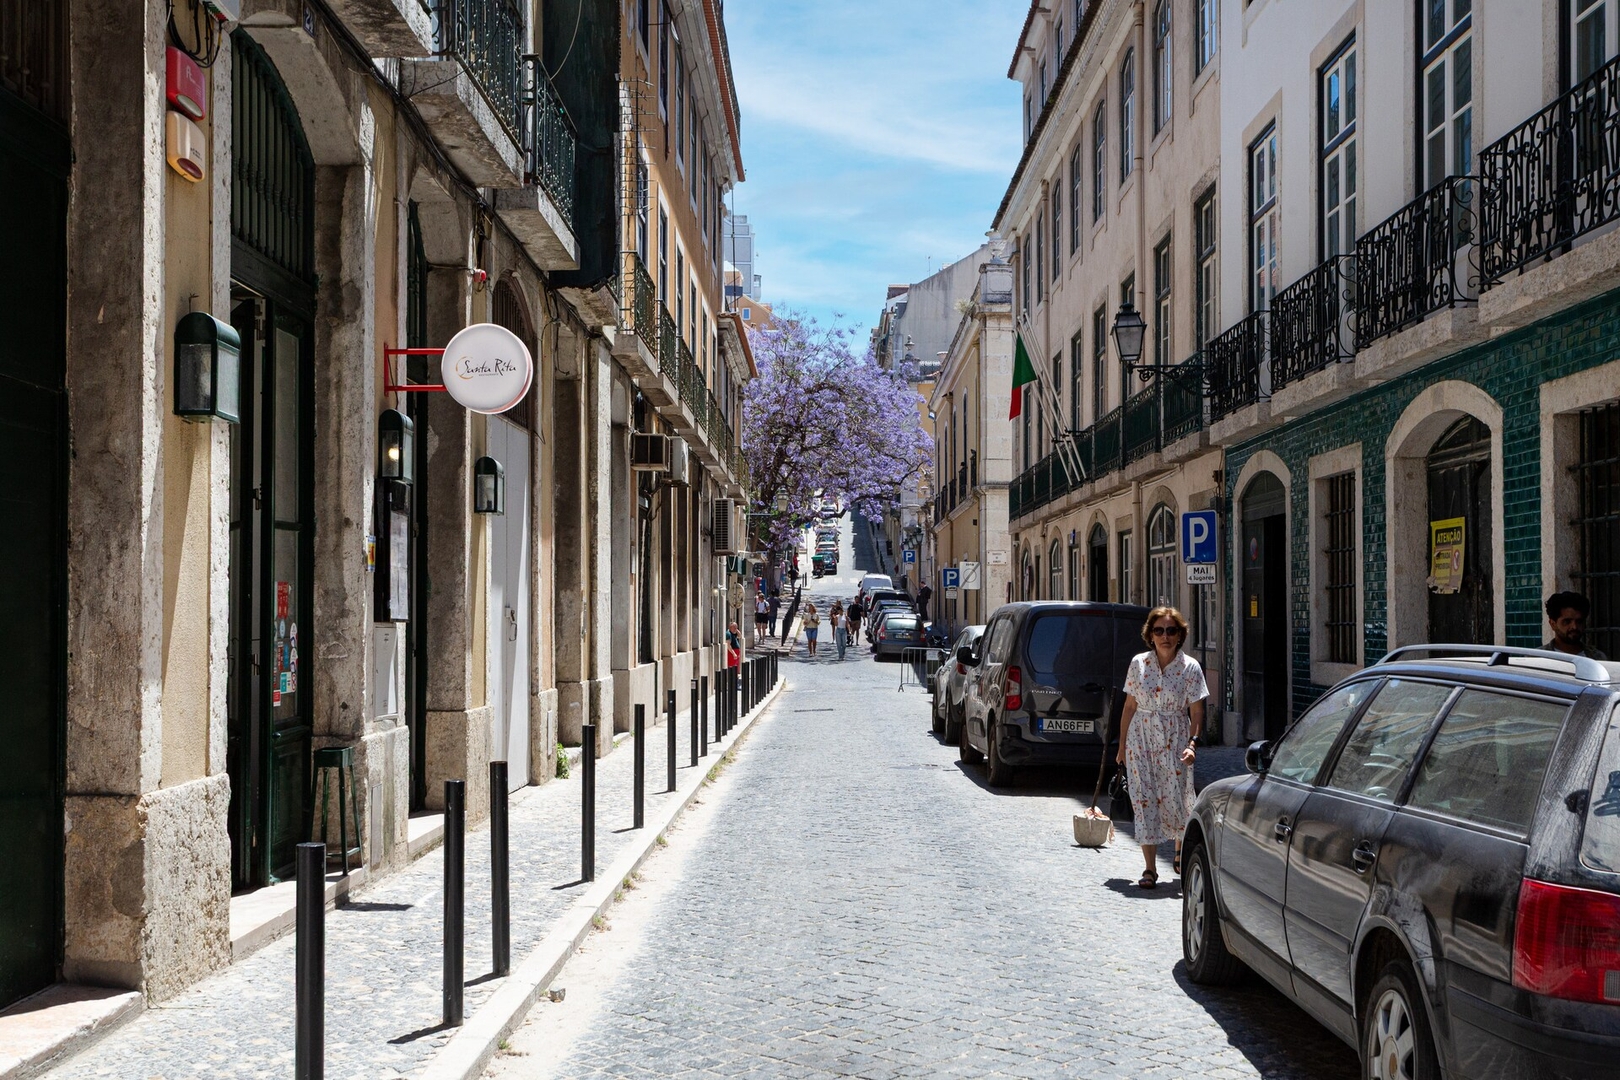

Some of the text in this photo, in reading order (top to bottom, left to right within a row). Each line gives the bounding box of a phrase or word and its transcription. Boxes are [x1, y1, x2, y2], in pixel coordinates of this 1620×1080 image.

[463, 358, 516, 376] Santa Rita
[1189, 517, 1208, 558] P
[1436, 529, 1461, 545] ATENÇÃO
[906, 552, 913, 561] P
[947, 571, 957, 585] P
[1047, 720, 1091, 731] AN66FF
